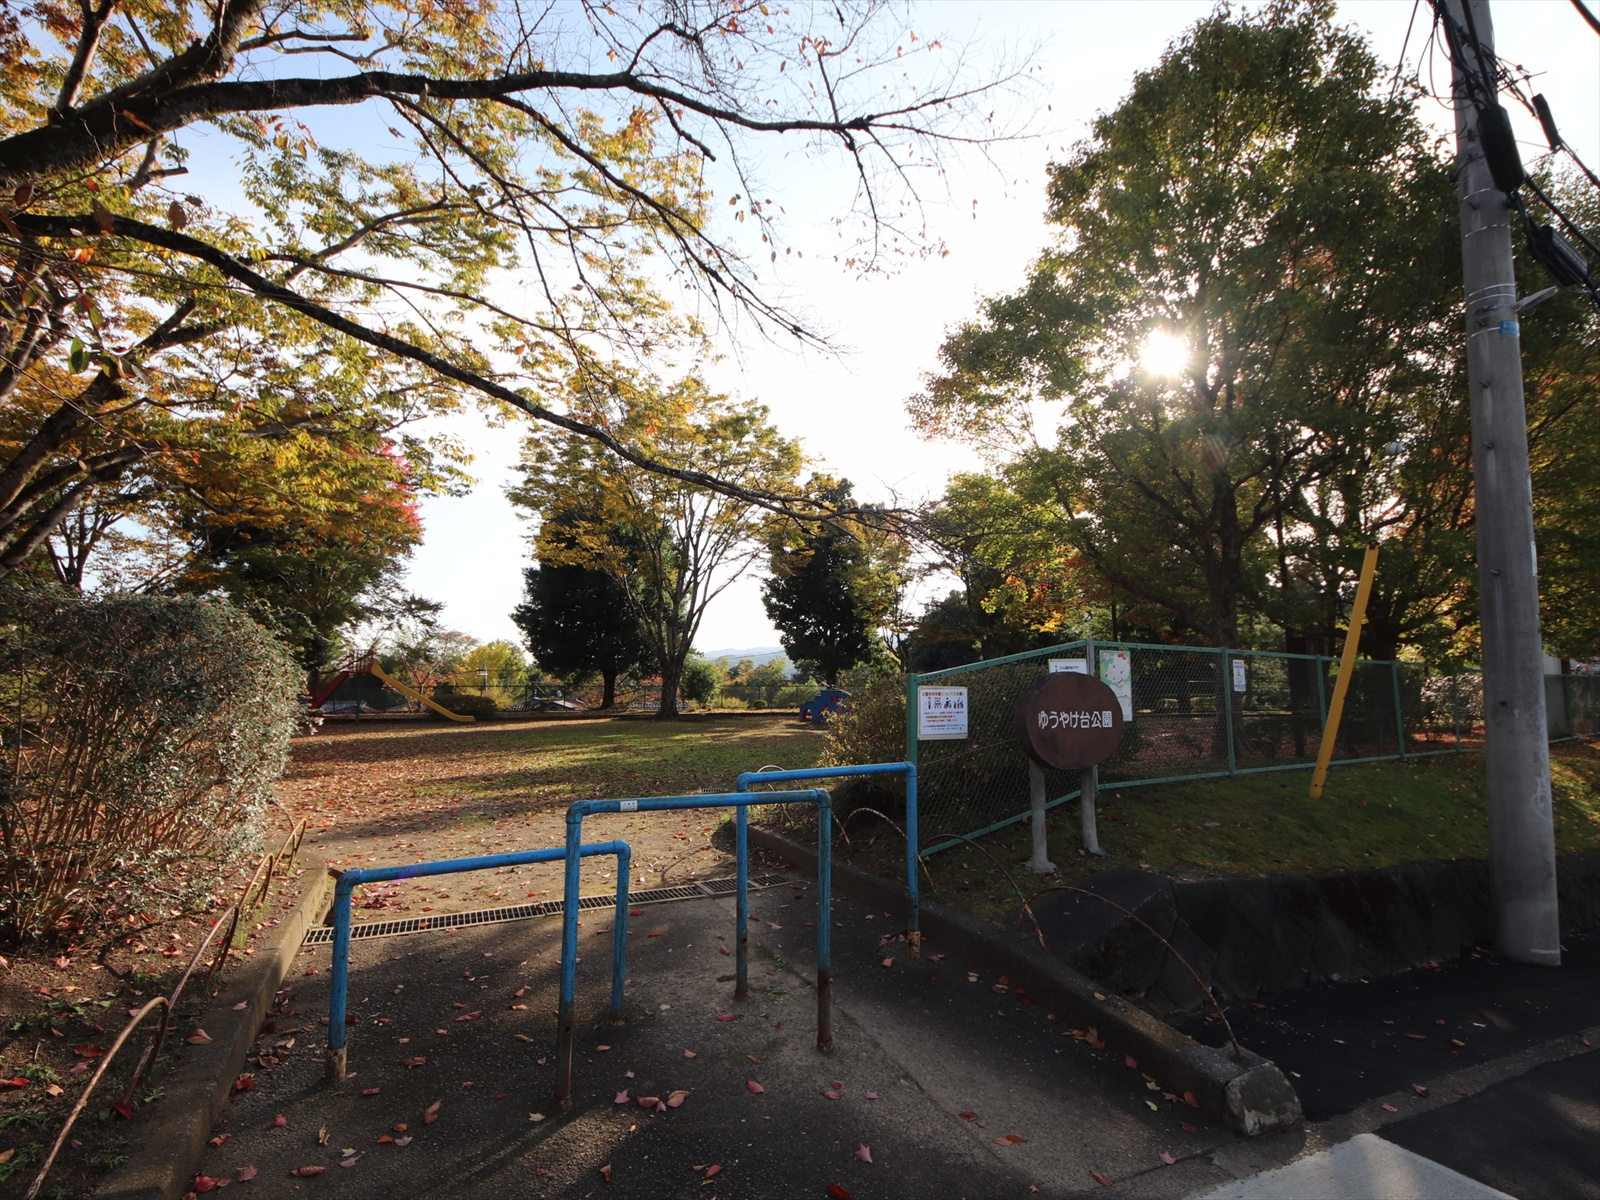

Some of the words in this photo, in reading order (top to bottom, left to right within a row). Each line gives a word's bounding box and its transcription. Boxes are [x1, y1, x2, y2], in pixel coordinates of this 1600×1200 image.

[1038, 710, 1113, 729] ゆうやけ台公園
